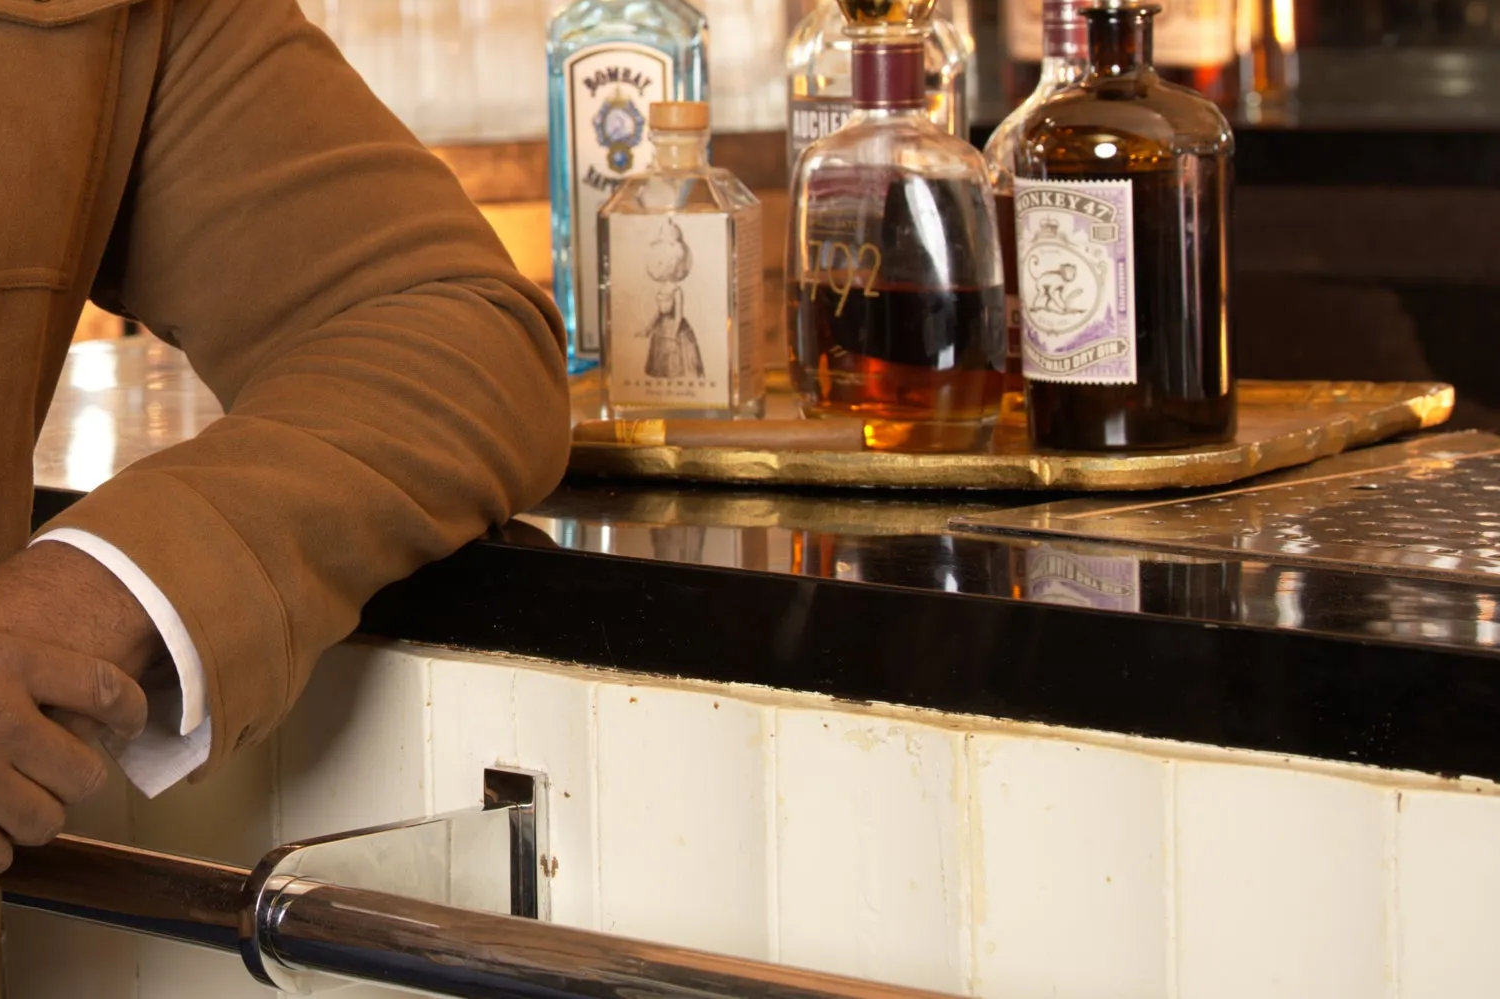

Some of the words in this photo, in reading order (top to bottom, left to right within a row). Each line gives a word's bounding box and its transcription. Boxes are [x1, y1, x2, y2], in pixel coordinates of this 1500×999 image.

[583, 67, 651, 98] BOMBAY
[1082, 200, 1111, 219] 47
[1071, 350, 1096, 370] DRY
[1097, 341, 1119, 359] GIN
